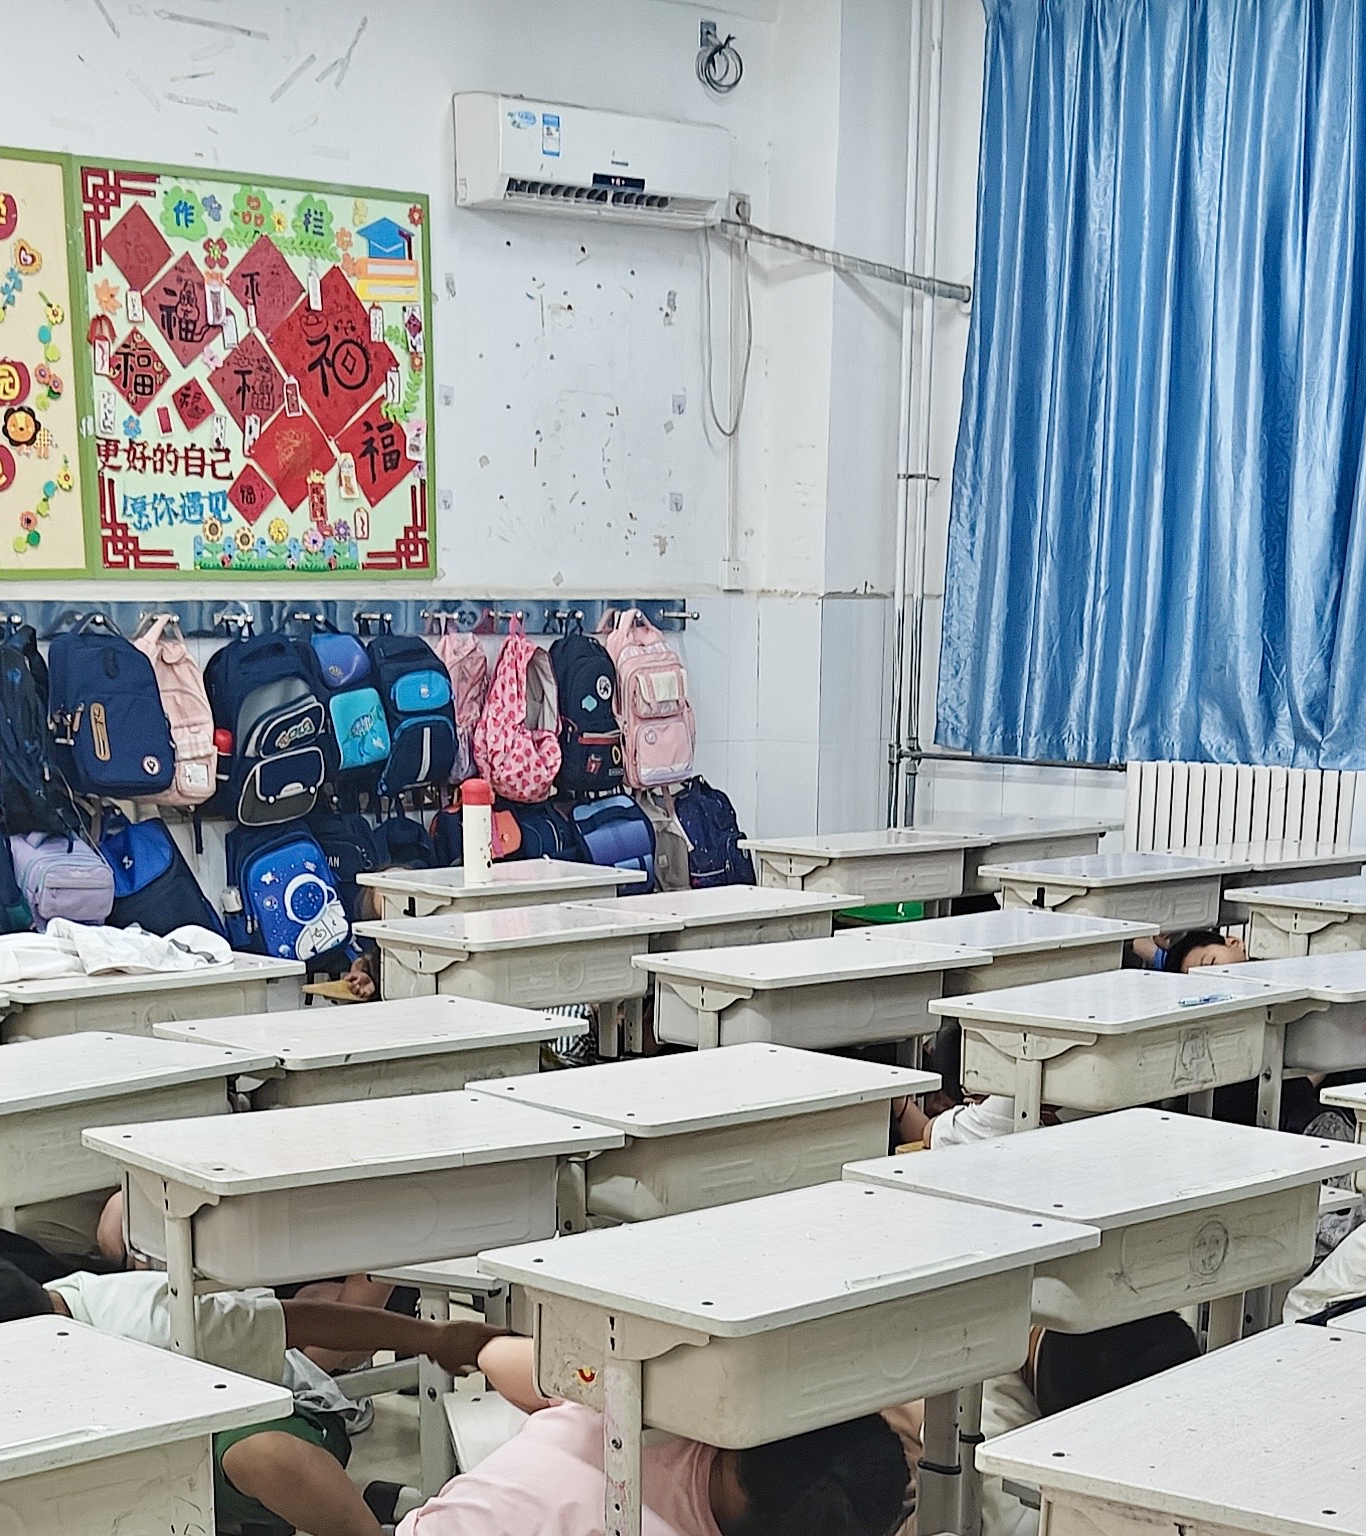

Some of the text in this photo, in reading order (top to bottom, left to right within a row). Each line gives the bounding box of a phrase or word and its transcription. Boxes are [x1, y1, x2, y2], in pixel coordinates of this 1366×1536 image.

[115, 343, 154, 396] 福
[96, 436, 234, 481] 更好的自己
[359, 421, 401, 485] 福
[122, 489, 234, 531] 愿你遇见
